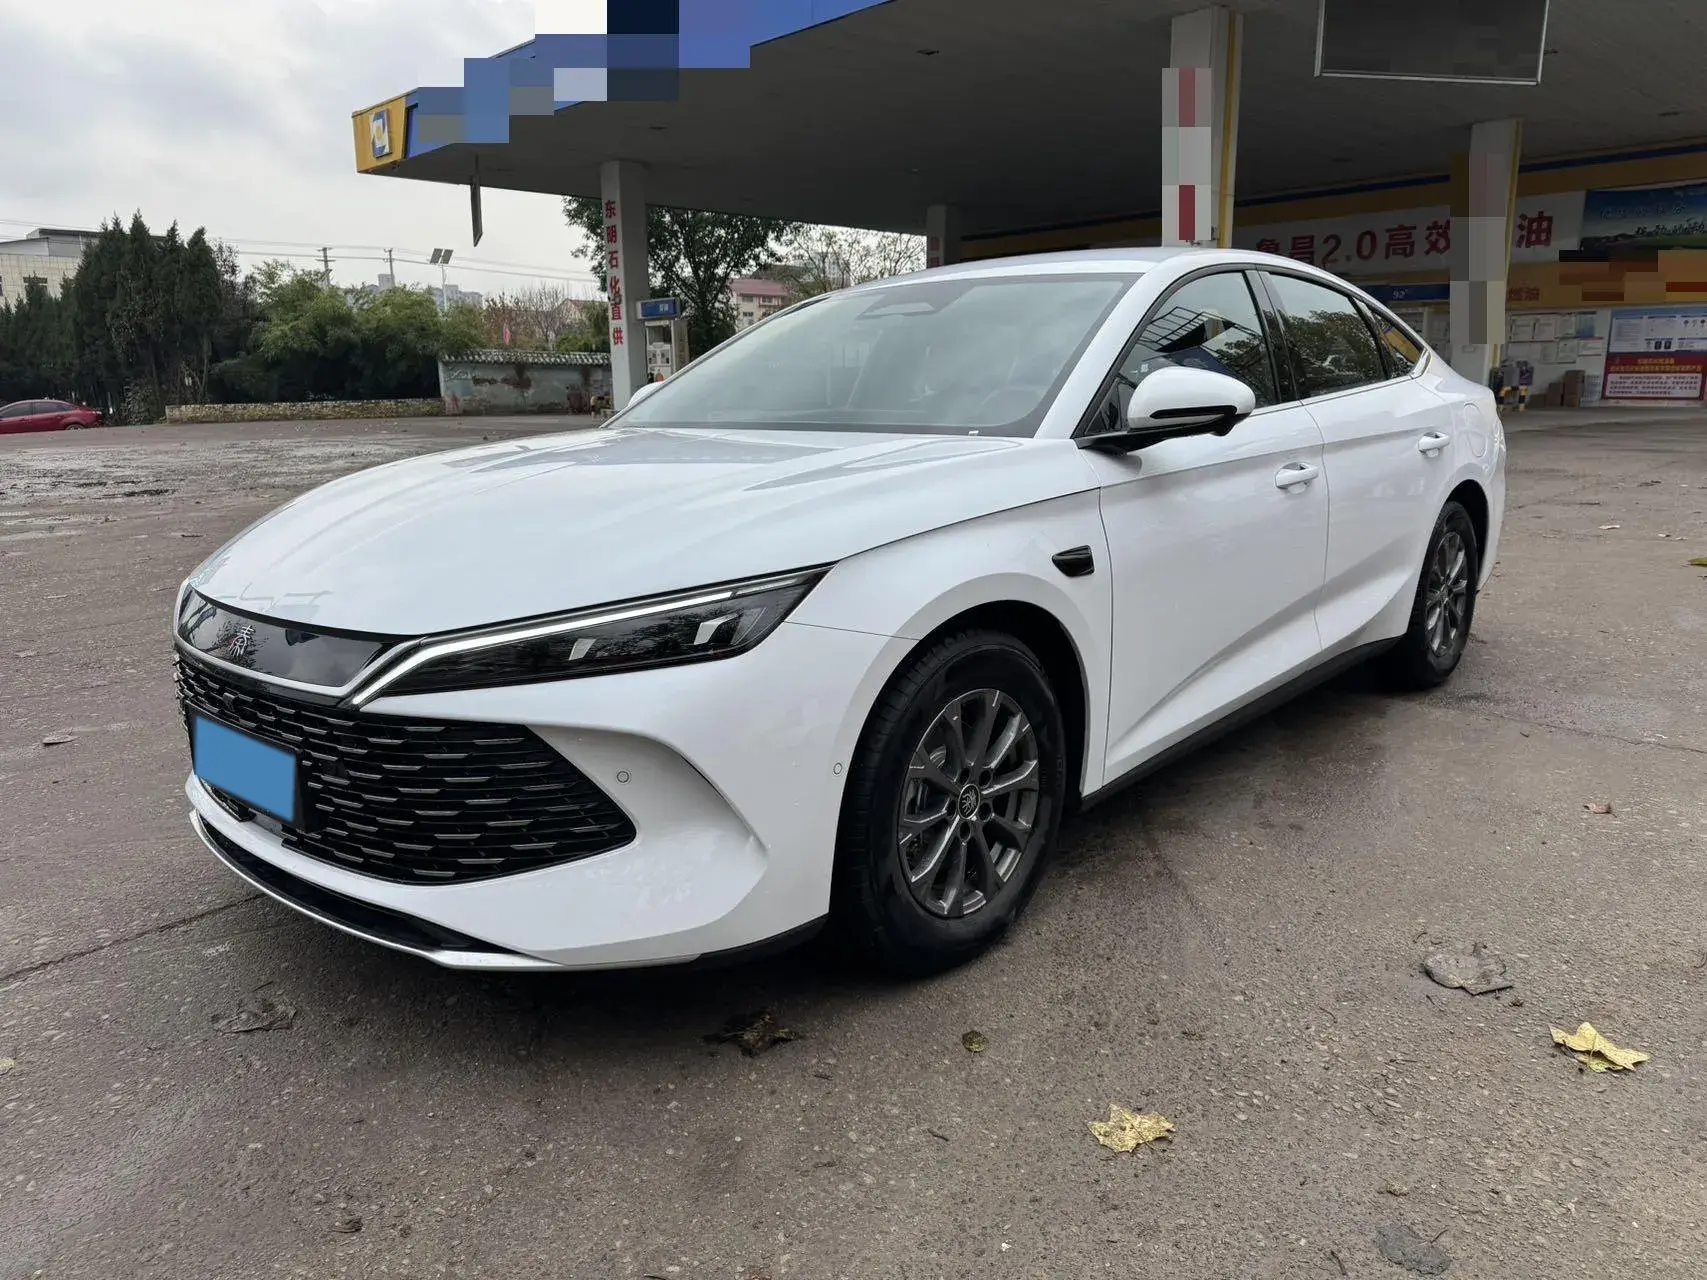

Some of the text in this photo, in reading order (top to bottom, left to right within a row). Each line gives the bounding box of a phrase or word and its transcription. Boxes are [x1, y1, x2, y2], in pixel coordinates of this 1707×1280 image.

[604, 199, 624, 346] 东明石化直供
